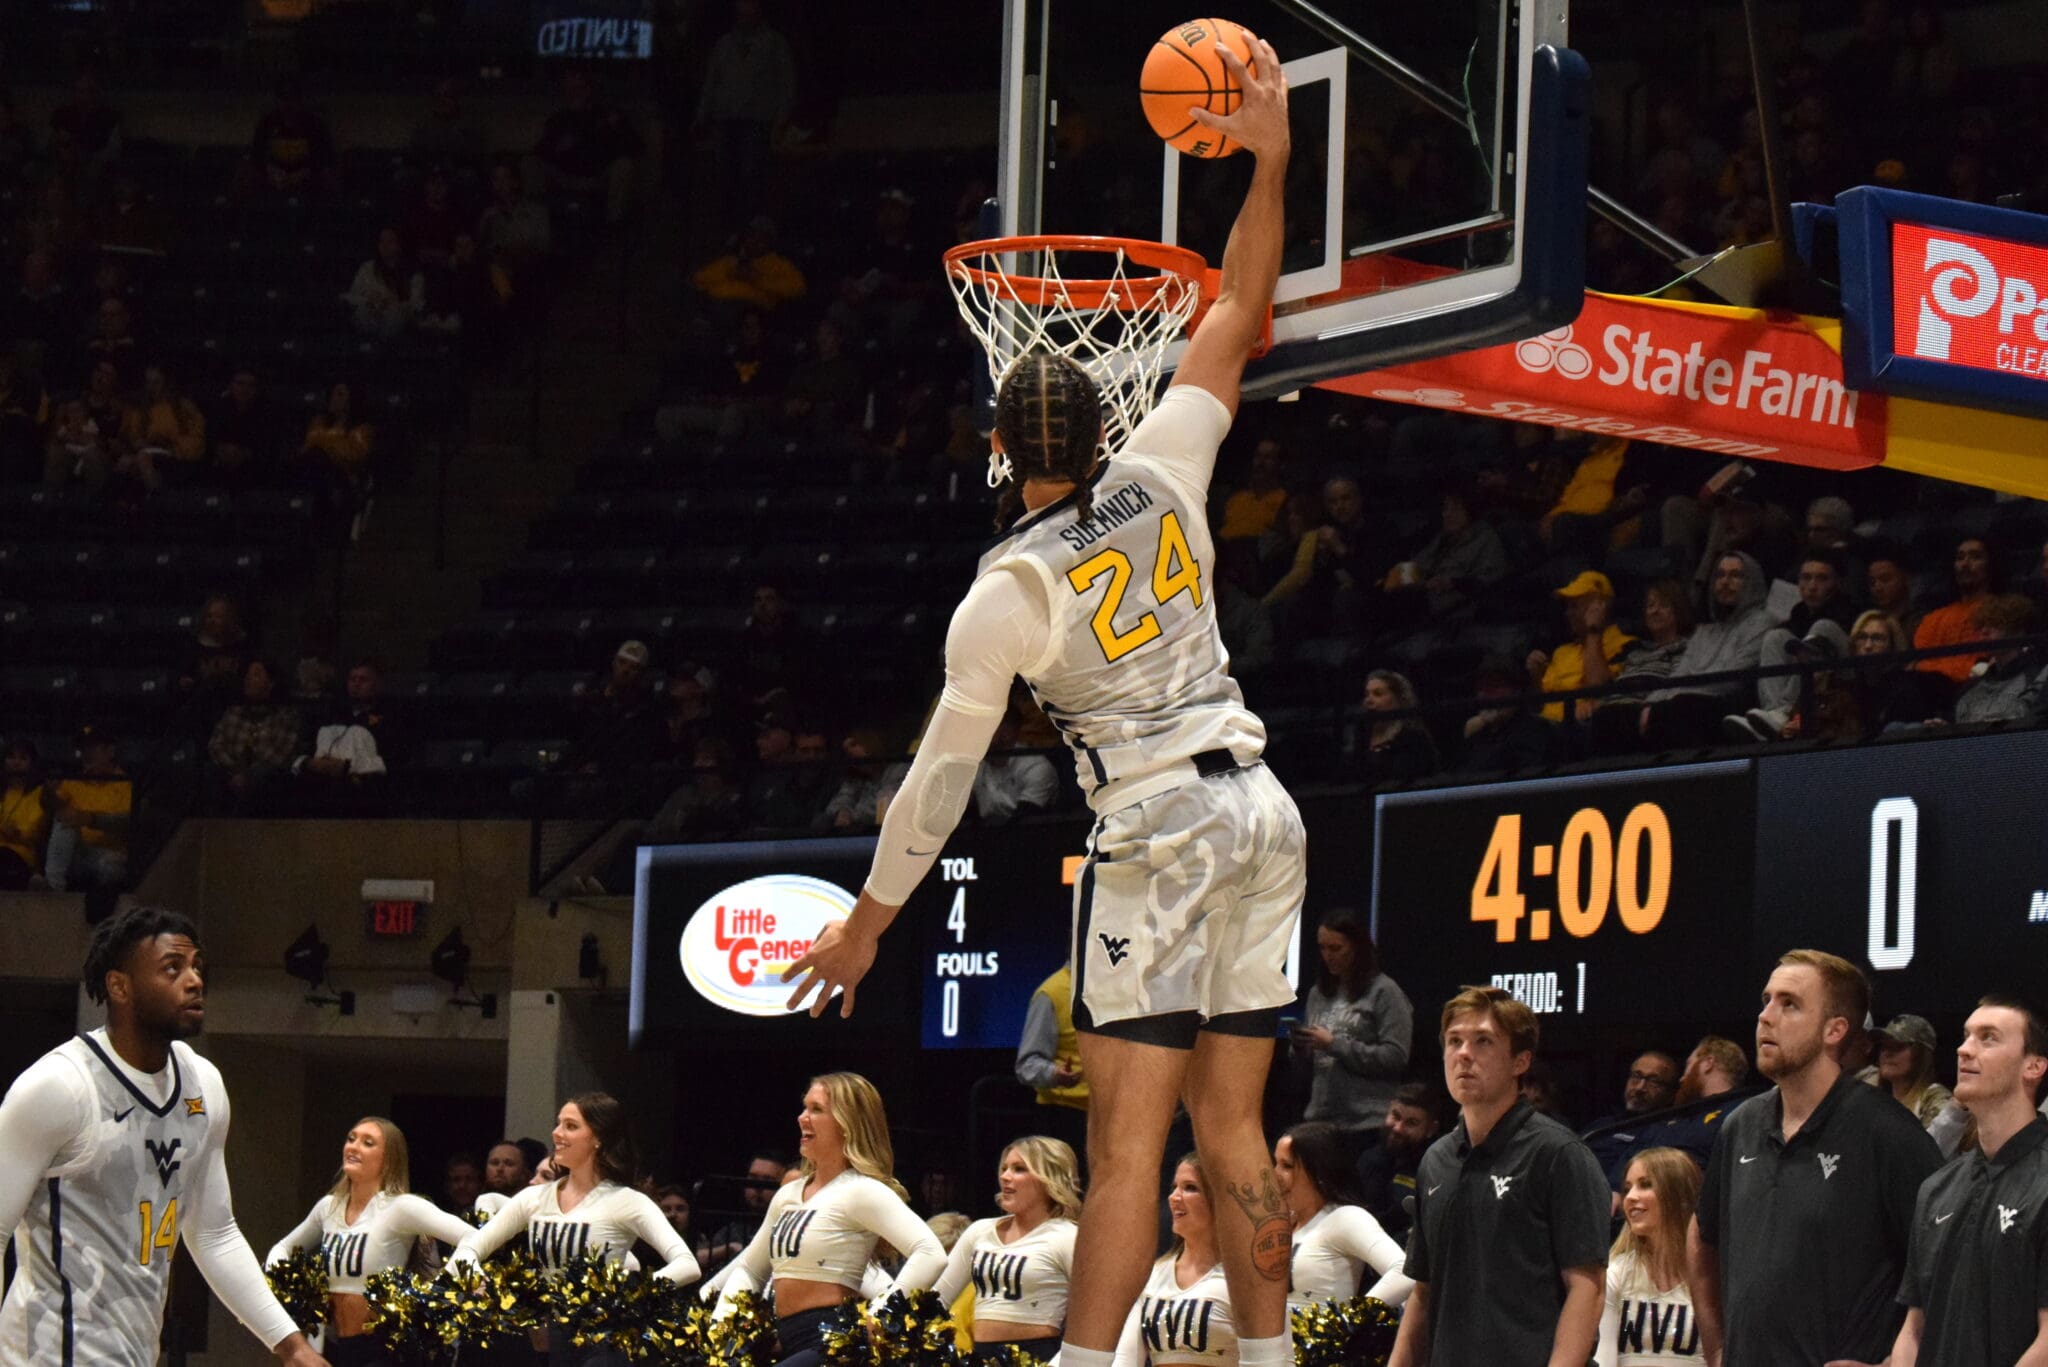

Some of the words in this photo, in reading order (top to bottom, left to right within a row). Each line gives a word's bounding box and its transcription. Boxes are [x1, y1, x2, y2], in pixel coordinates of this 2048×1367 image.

[1059, 482, 1153, 551] SUEMNICK
[1066, 509, 1204, 664] 24
[941, 858, 978, 881] TOL
[1471, 802, 1672, 942] 4:00
[1868, 797, 1918, 970] 0
[375, 901, 415, 934] EXIT
[715, 905, 776, 951] Little
[947, 887, 966, 943] 4
[729, 937, 812, 987] Gene
[937, 952, 998, 977] FOULS
[943, 980, 959, 1037] 0
[139, 1198, 177, 1265] 14
[971, 1250, 1028, 1301] WVU
[1141, 1297, 1213, 1352] WVU
[1618, 1300, 1699, 1356] WVU
